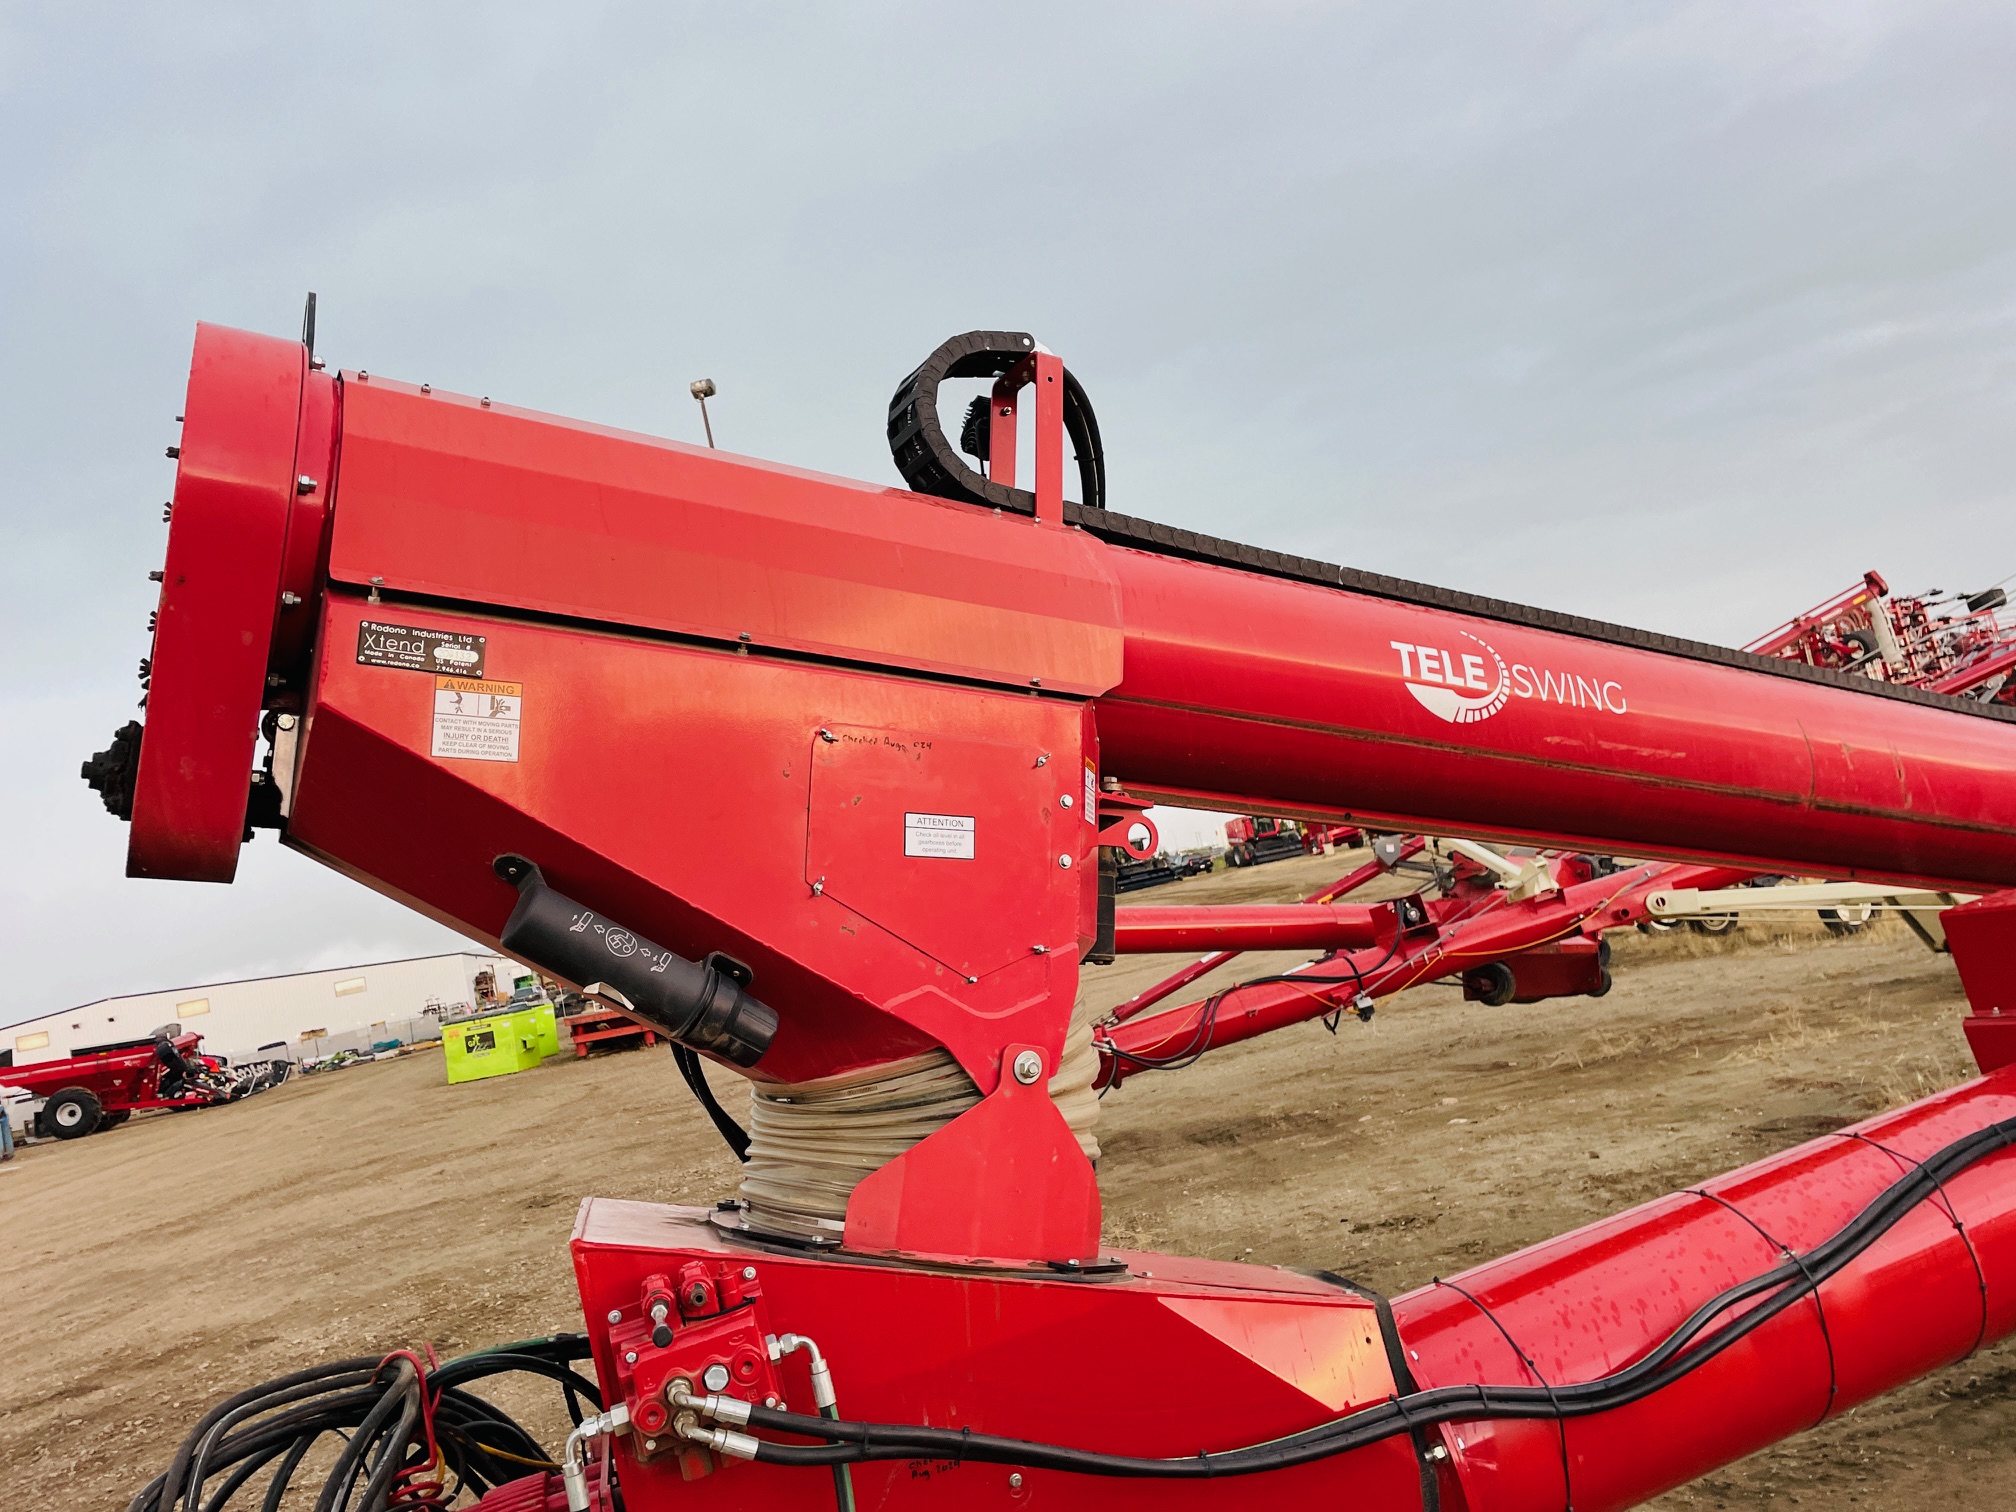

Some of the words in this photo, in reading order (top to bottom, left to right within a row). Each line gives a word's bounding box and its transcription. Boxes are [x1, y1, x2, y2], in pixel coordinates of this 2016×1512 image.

[370, 623, 407, 635] Rodono
[412, 629, 453, 641] Industries
[458, 635, 475, 644] Ltd.
[364, 632, 425, 655] Xtend
[441, 641, 461, 650] Serial
[364, 649, 383, 657] Made
[399, 653, 425, 662] Canada
[449, 659, 472, 668] Patent
[1390, 641, 1488, 691] TELE
[1511, 664, 1627, 715] SWING
[457, 681, 515, 694] WARNING
[443, 732, 470, 740] INJURY
[483, 735, 509, 744] DEATH!
[480, 750, 513, 758] OPERATION
[917, 817, 964, 828] ATTENTION
[921, 847, 947, 855] operating
